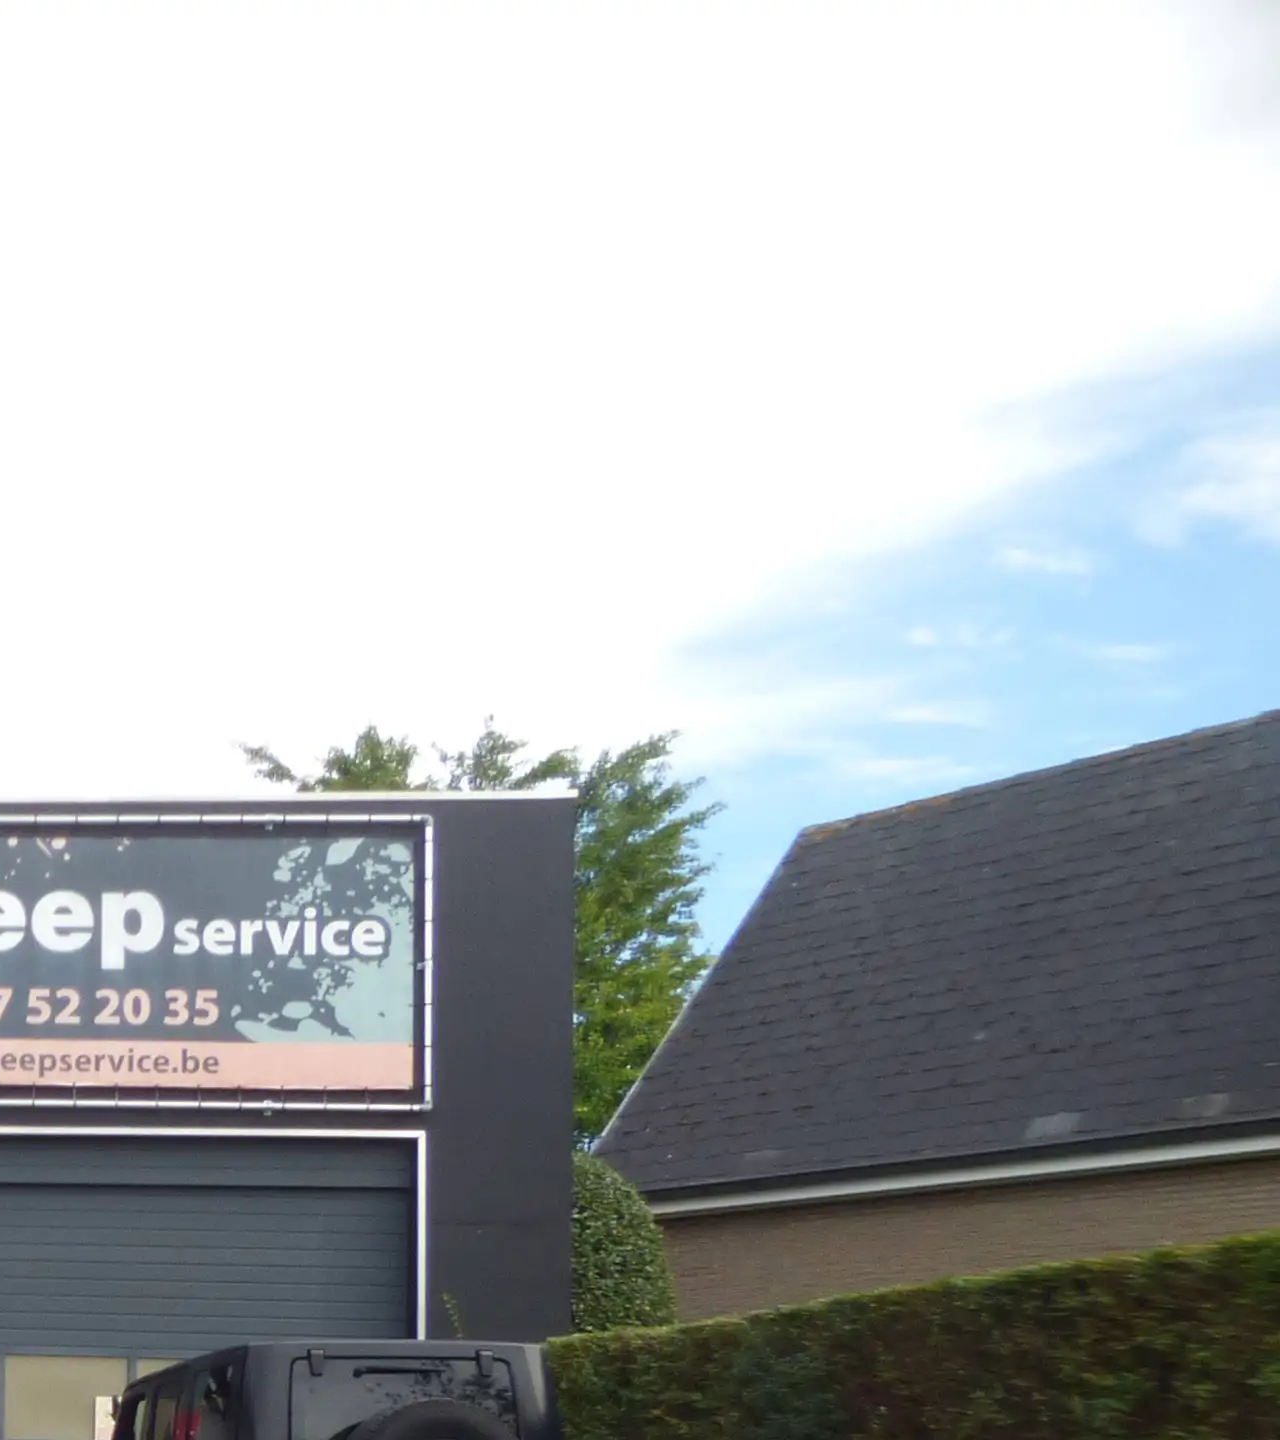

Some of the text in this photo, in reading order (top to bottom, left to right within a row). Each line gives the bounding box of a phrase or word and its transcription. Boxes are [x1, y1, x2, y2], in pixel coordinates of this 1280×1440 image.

[173, 907, 387, 956] service
[26, 988, 81, 1025] 52
[93, 988, 151, 1026] 20
[163, 989, 220, 1026] 35
